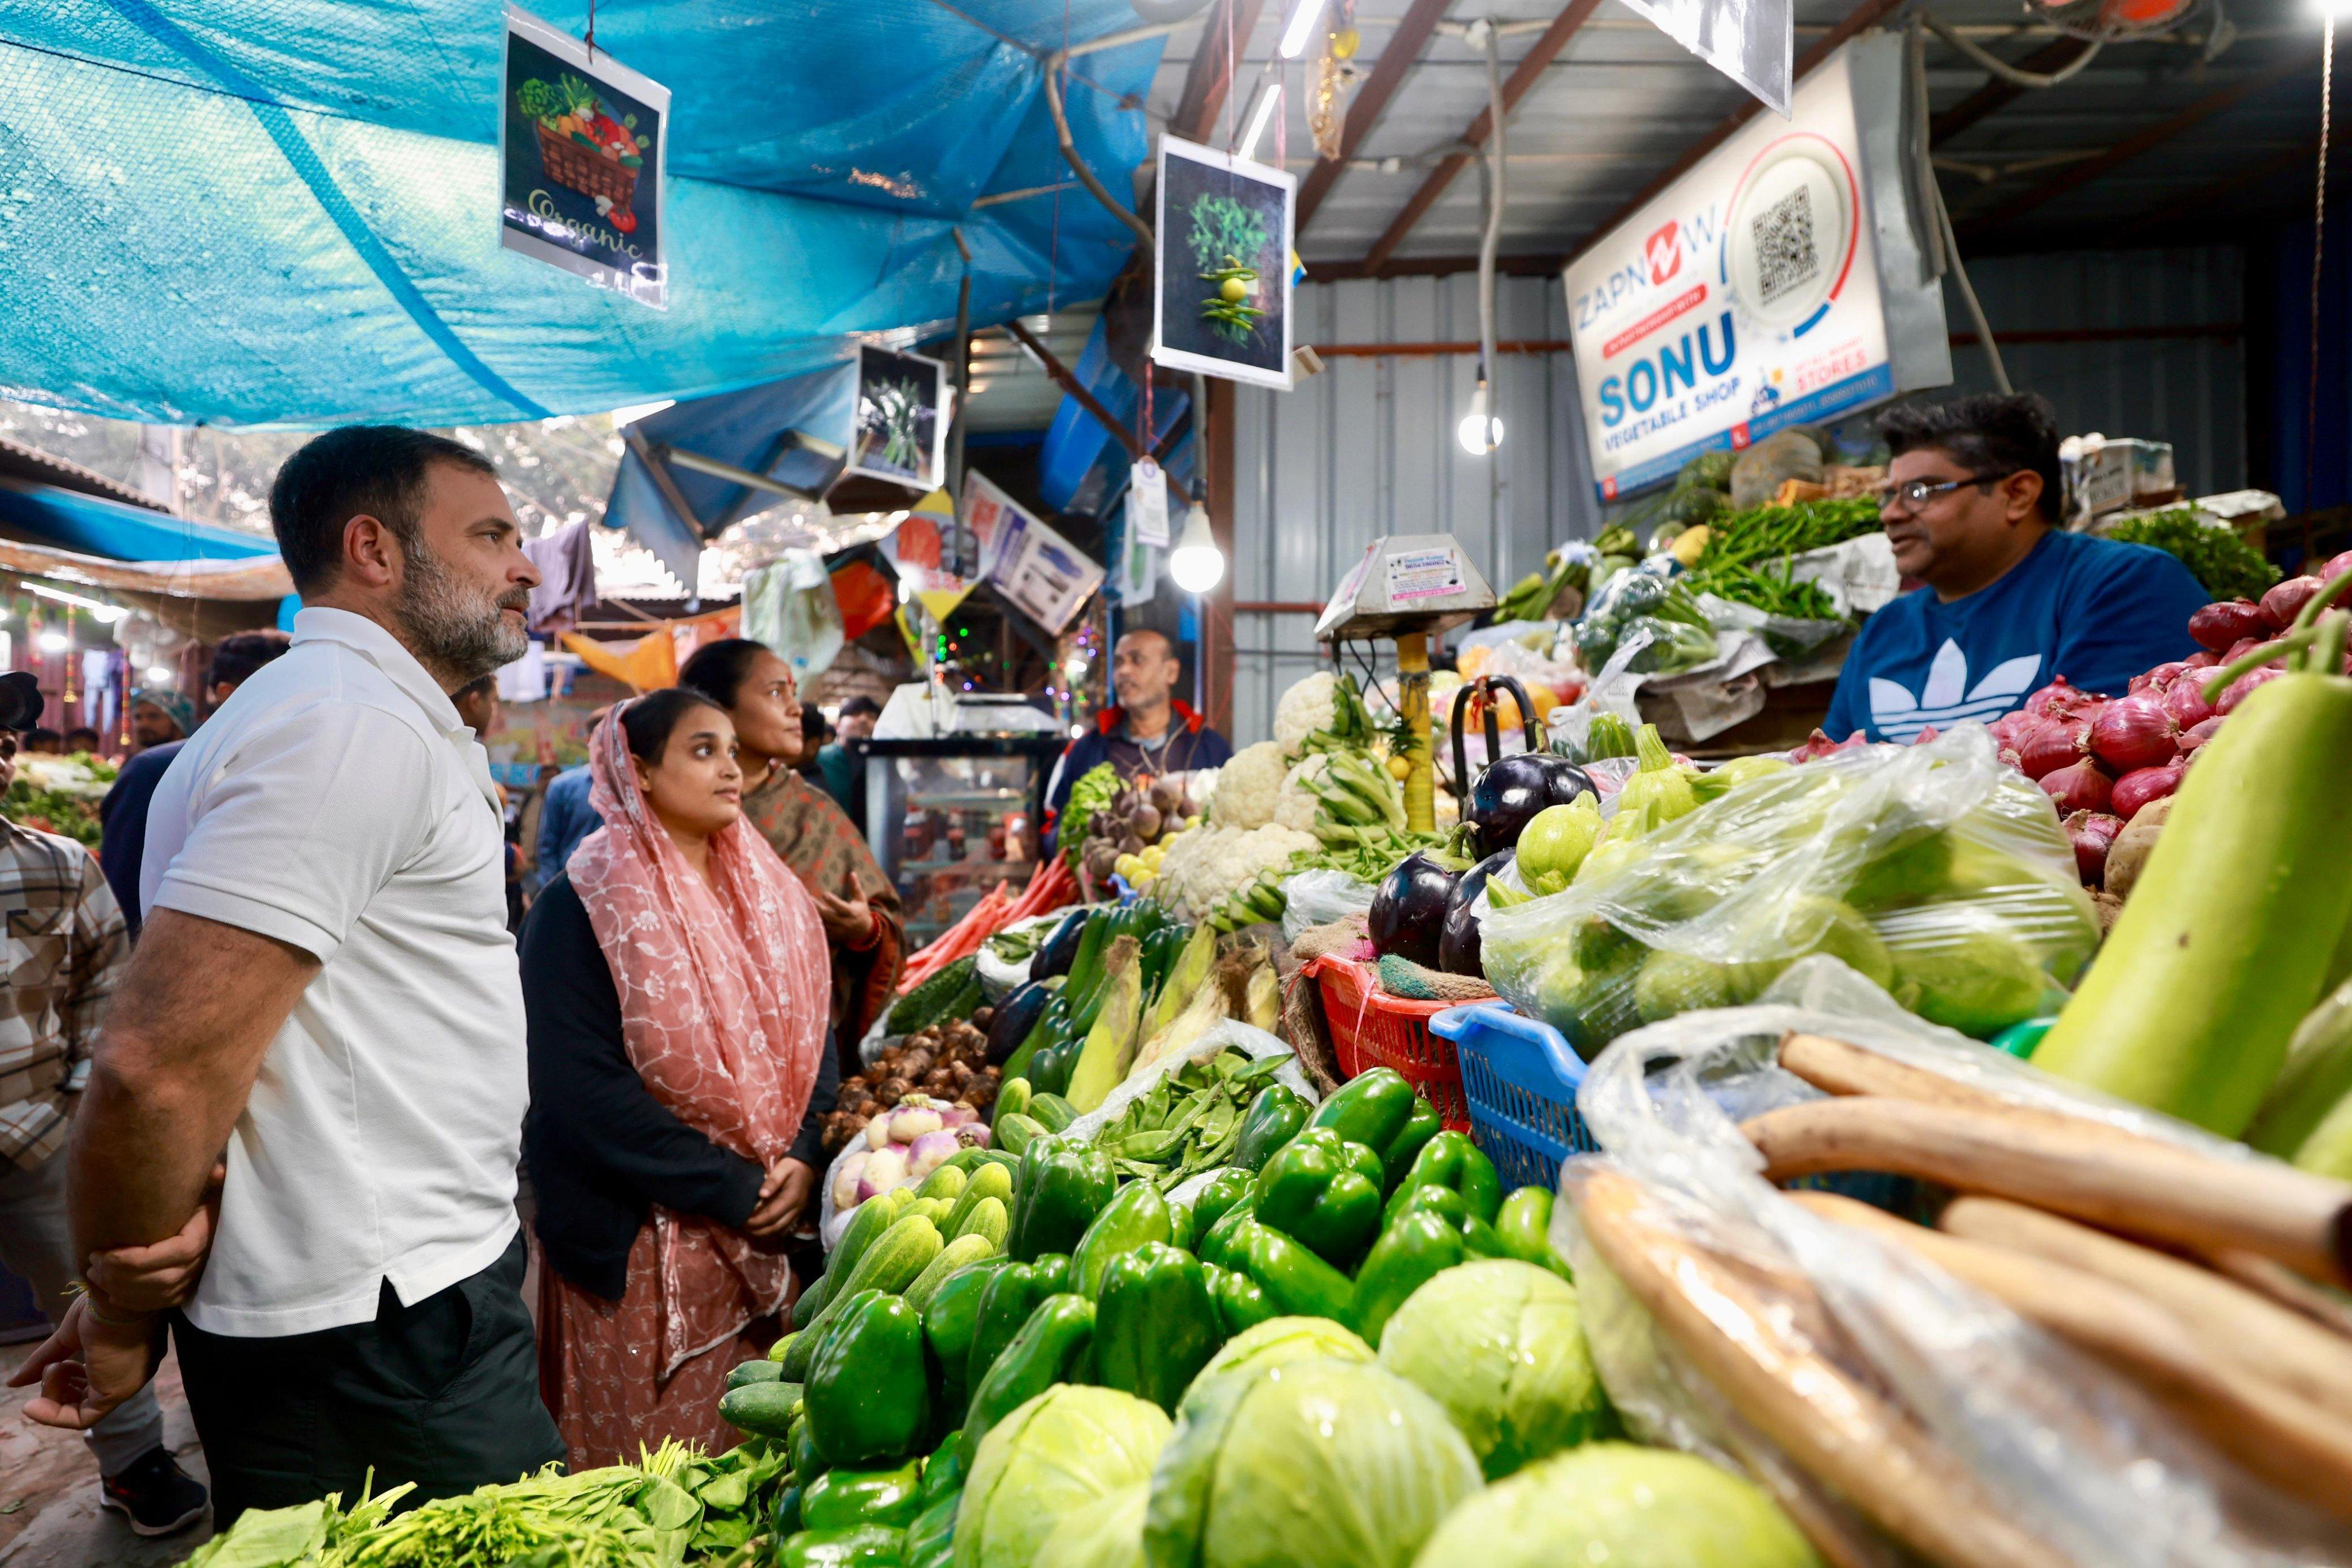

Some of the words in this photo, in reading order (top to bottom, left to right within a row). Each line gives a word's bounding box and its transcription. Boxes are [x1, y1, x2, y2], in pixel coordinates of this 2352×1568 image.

[528, 189, 644, 259] Organic
[1599, 311, 1736, 426] SONU
[1797, 348, 1867, 392] STORES
[1604, 401, 1687, 451] VEGETABLE
[1695, 377, 1740, 412] SHOP
